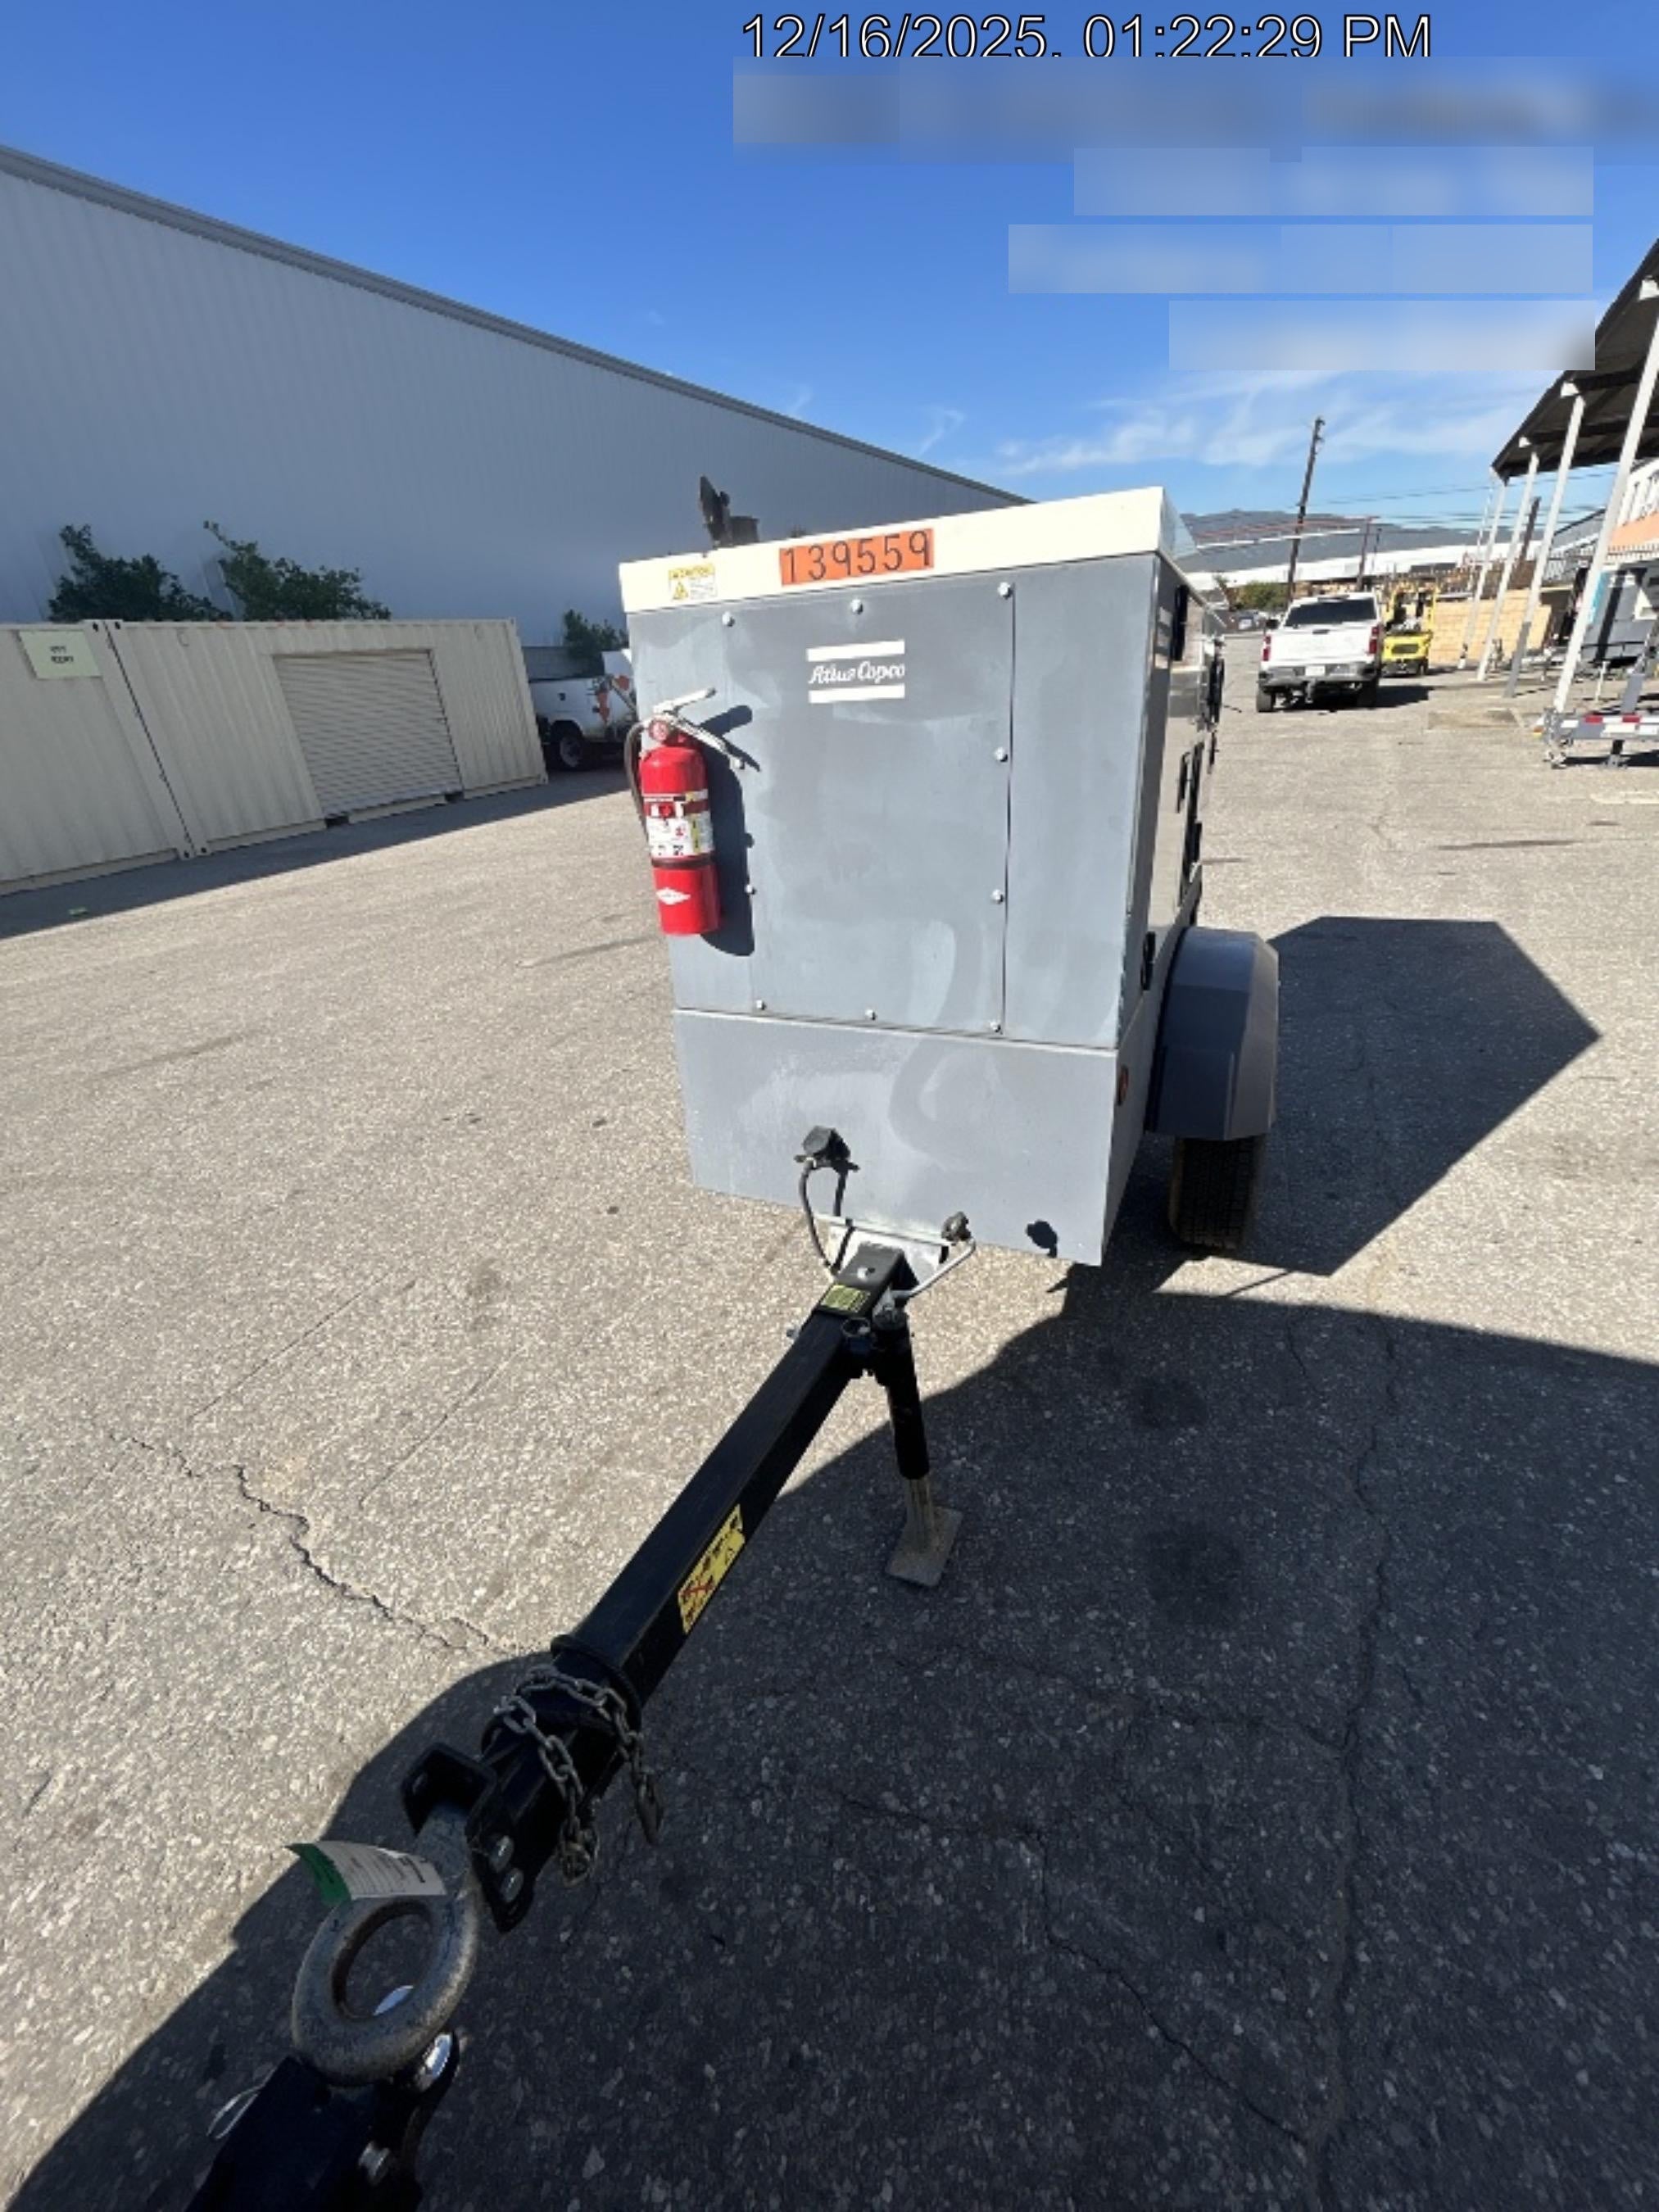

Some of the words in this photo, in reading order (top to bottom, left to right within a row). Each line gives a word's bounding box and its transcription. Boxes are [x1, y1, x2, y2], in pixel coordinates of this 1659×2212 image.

[785, 530, 931, 583] 139559
[808, 664, 856, 684] Atlas
[857, 660, 905, 684] Copco
